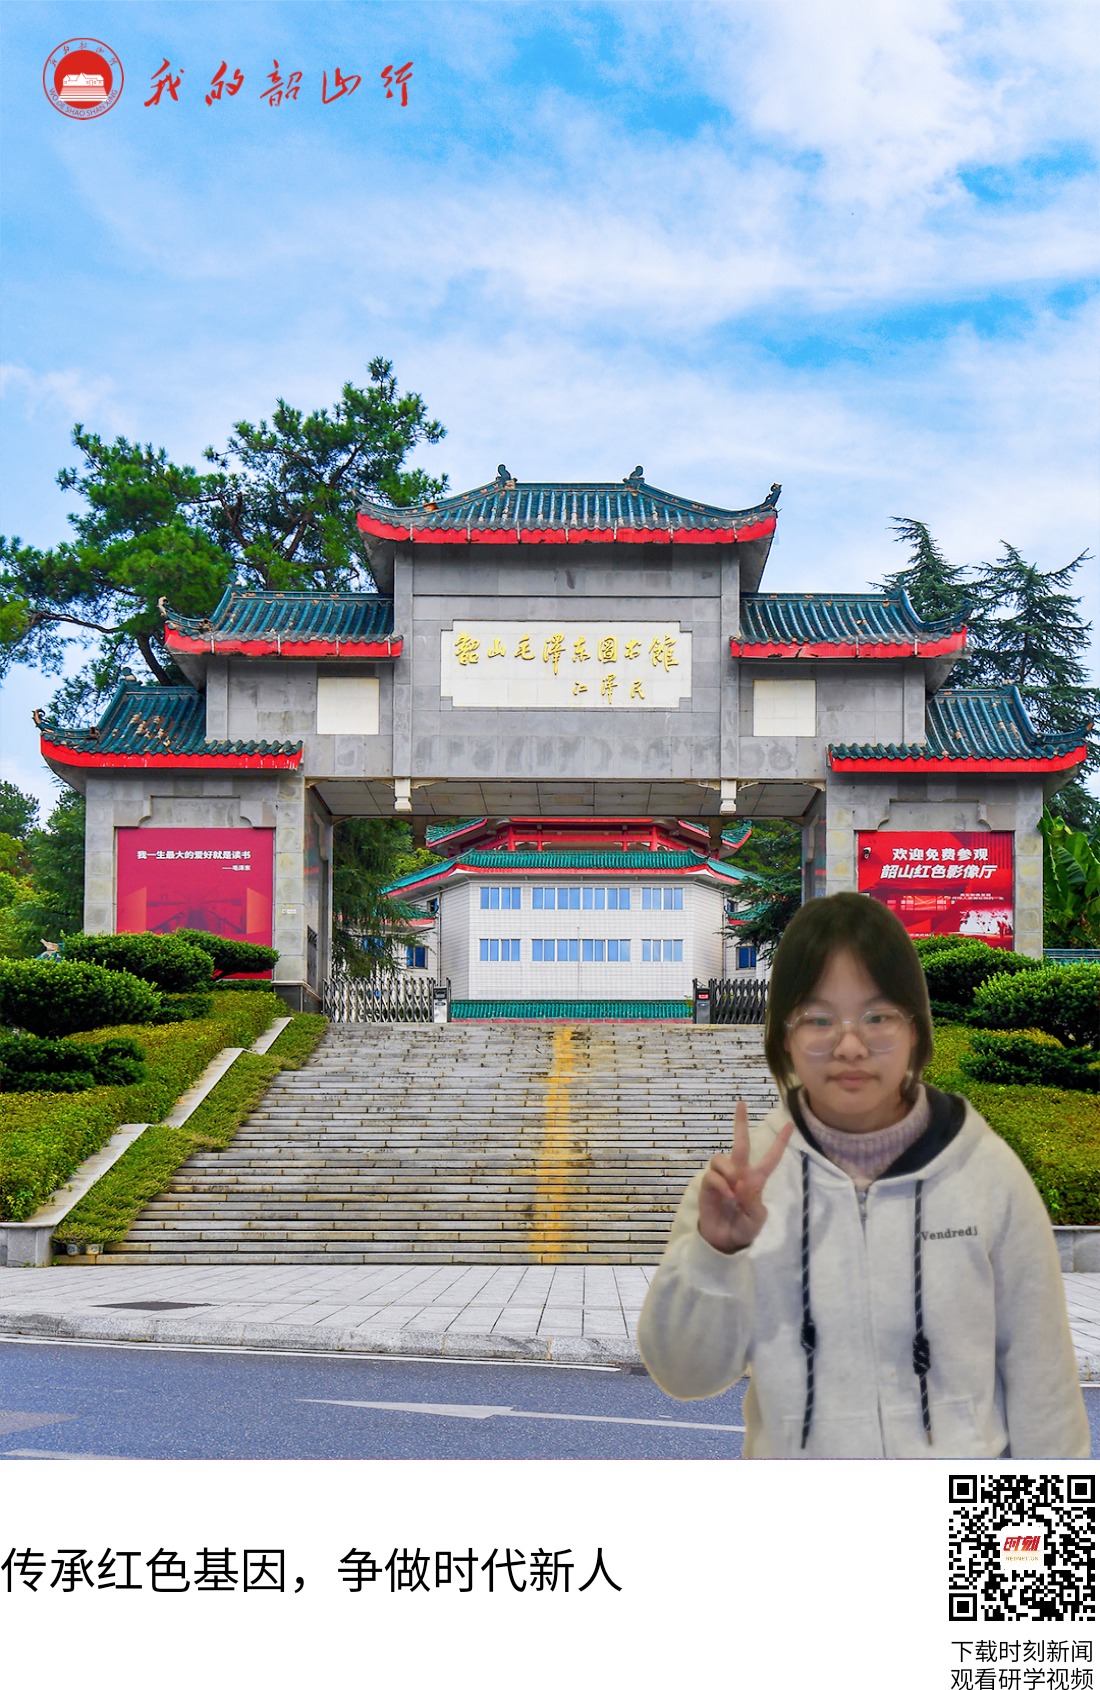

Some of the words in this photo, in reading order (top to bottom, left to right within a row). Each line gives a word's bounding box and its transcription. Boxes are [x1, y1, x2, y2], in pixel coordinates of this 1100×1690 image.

[136, 850, 251, 860] 我一生最大的爱好就是读书
[891, 848, 989, 861] 欢迎免费参观
[880, 864, 998, 879] 韶山红色影像厅
